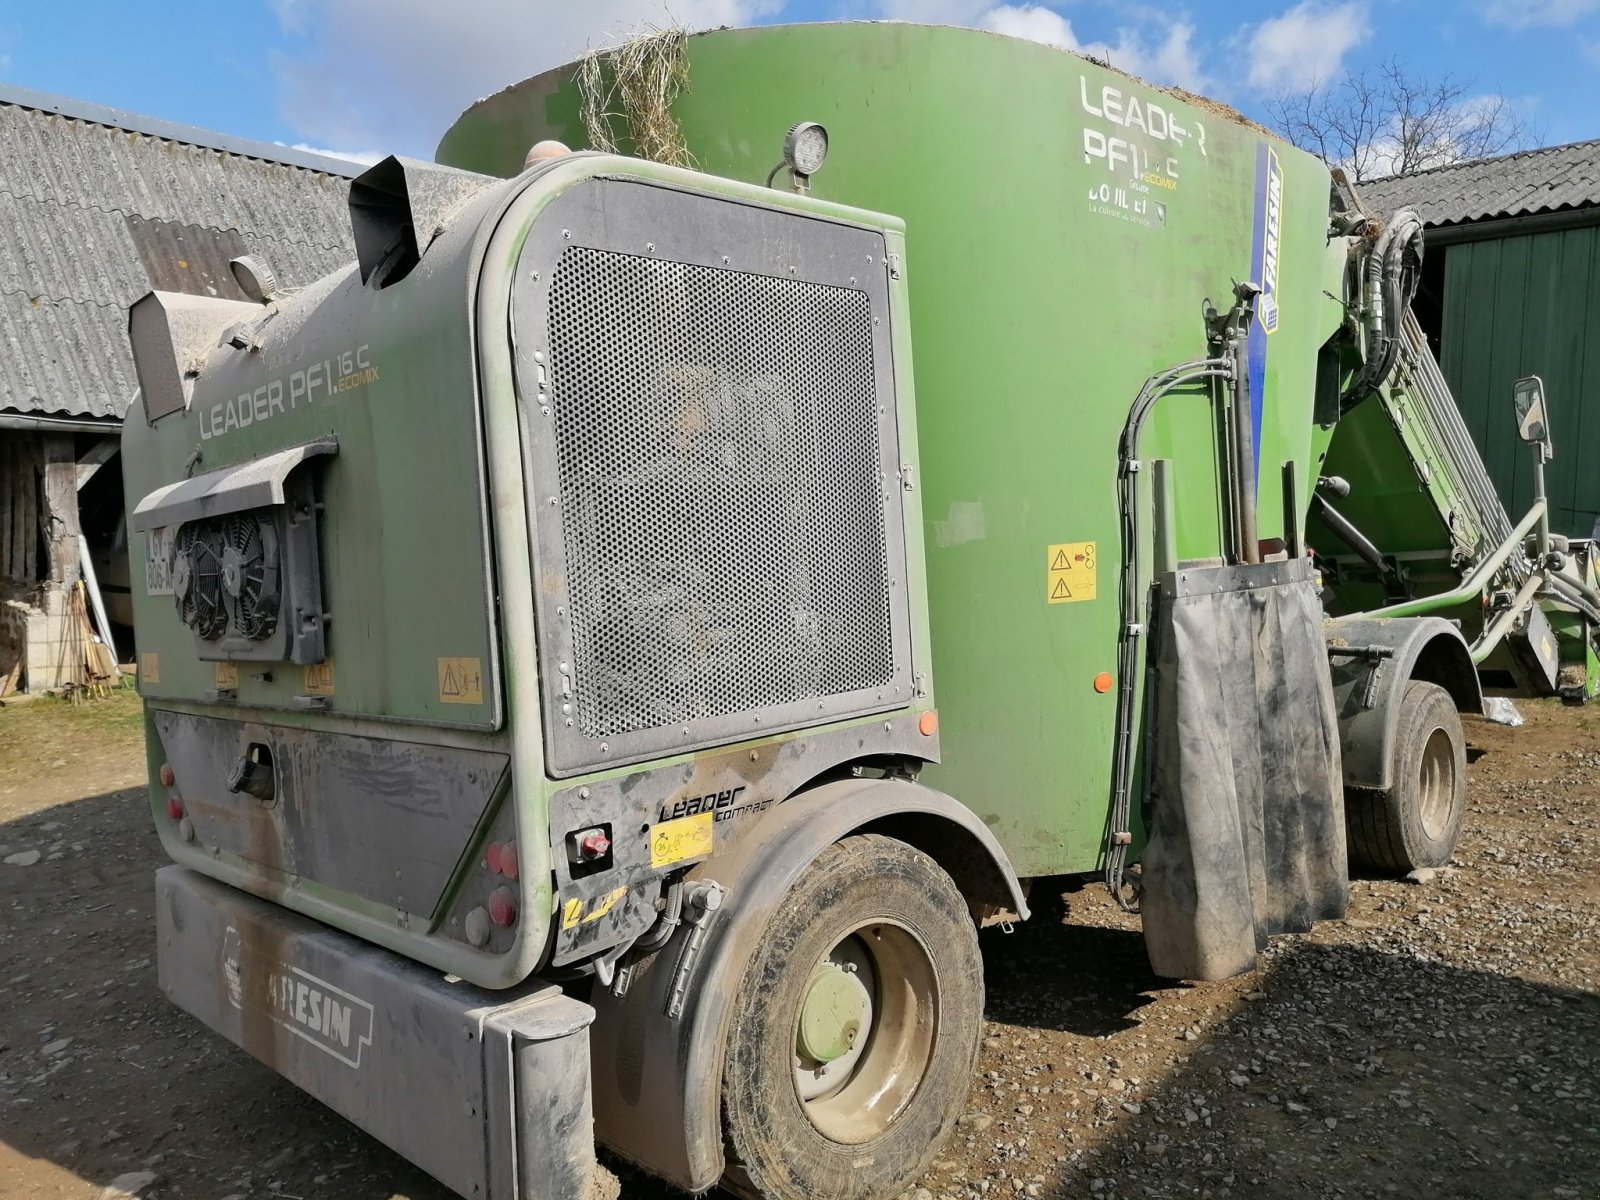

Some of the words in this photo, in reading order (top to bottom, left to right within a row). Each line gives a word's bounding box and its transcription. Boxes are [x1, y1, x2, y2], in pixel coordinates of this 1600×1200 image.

[1265, 170, 1281, 290] FARESIN
[200, 380, 285, 440] LEADER
[356, 344, 370, 369] C
[337, 366, 380, 393] ECOMIX
